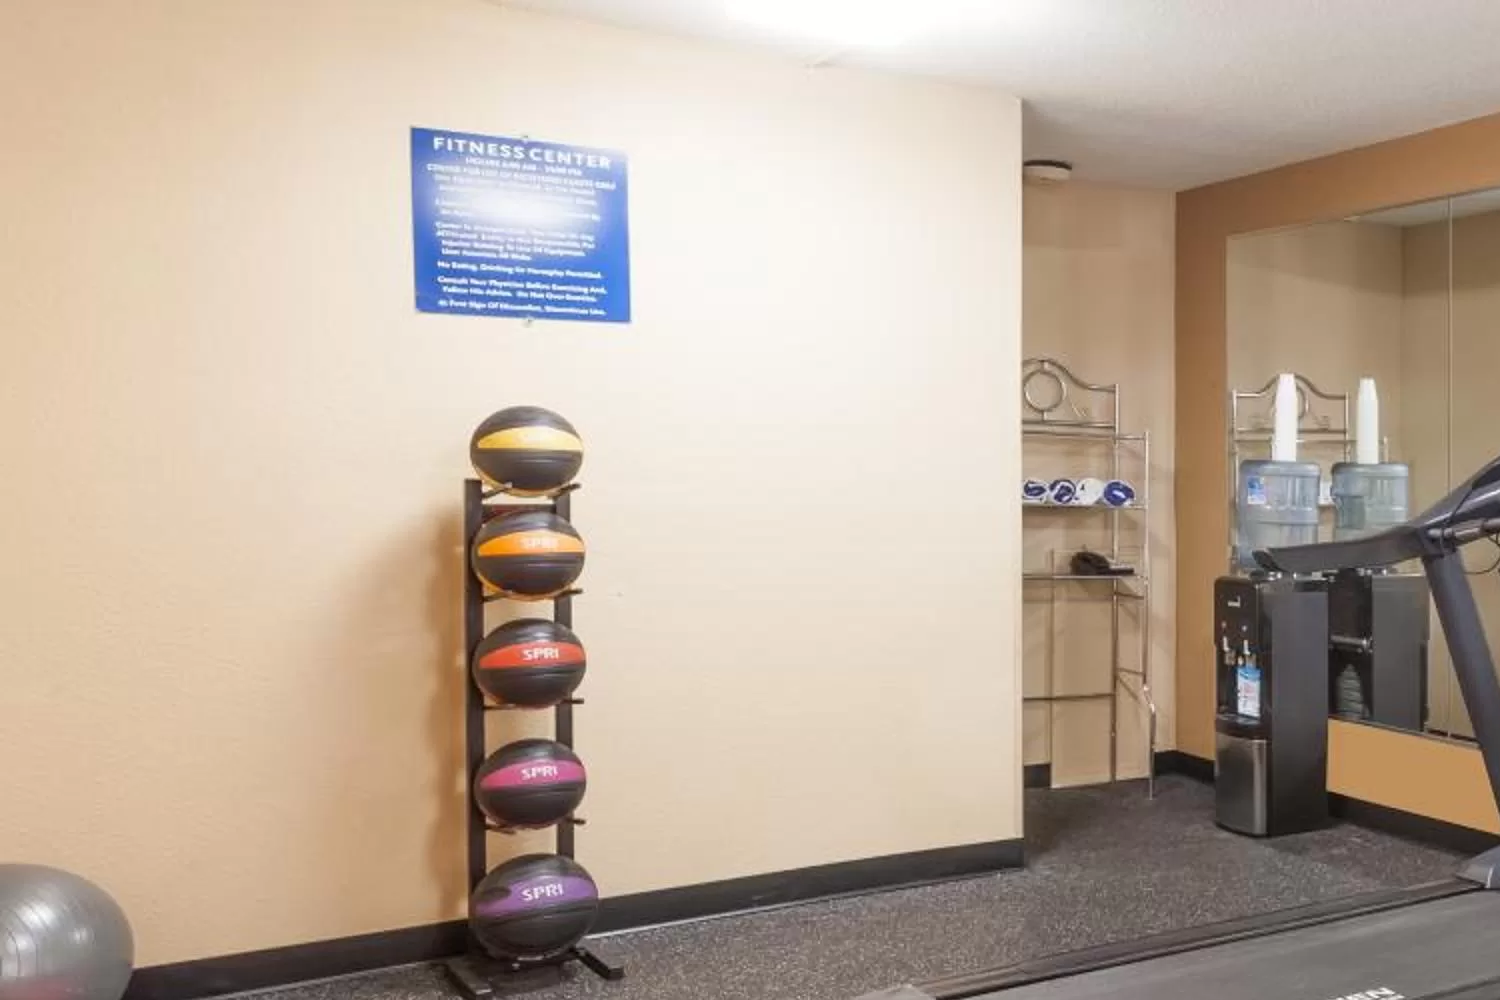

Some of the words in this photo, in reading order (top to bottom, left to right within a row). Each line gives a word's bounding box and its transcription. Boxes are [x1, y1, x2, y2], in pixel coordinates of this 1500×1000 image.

[433, 137, 524, 160] FITNESS
[529, 148, 611, 169] CENTER
[522, 648, 559, 660] SPRI
[521, 765, 558, 780] SPRI
[522, 884, 564, 900] SPRI
